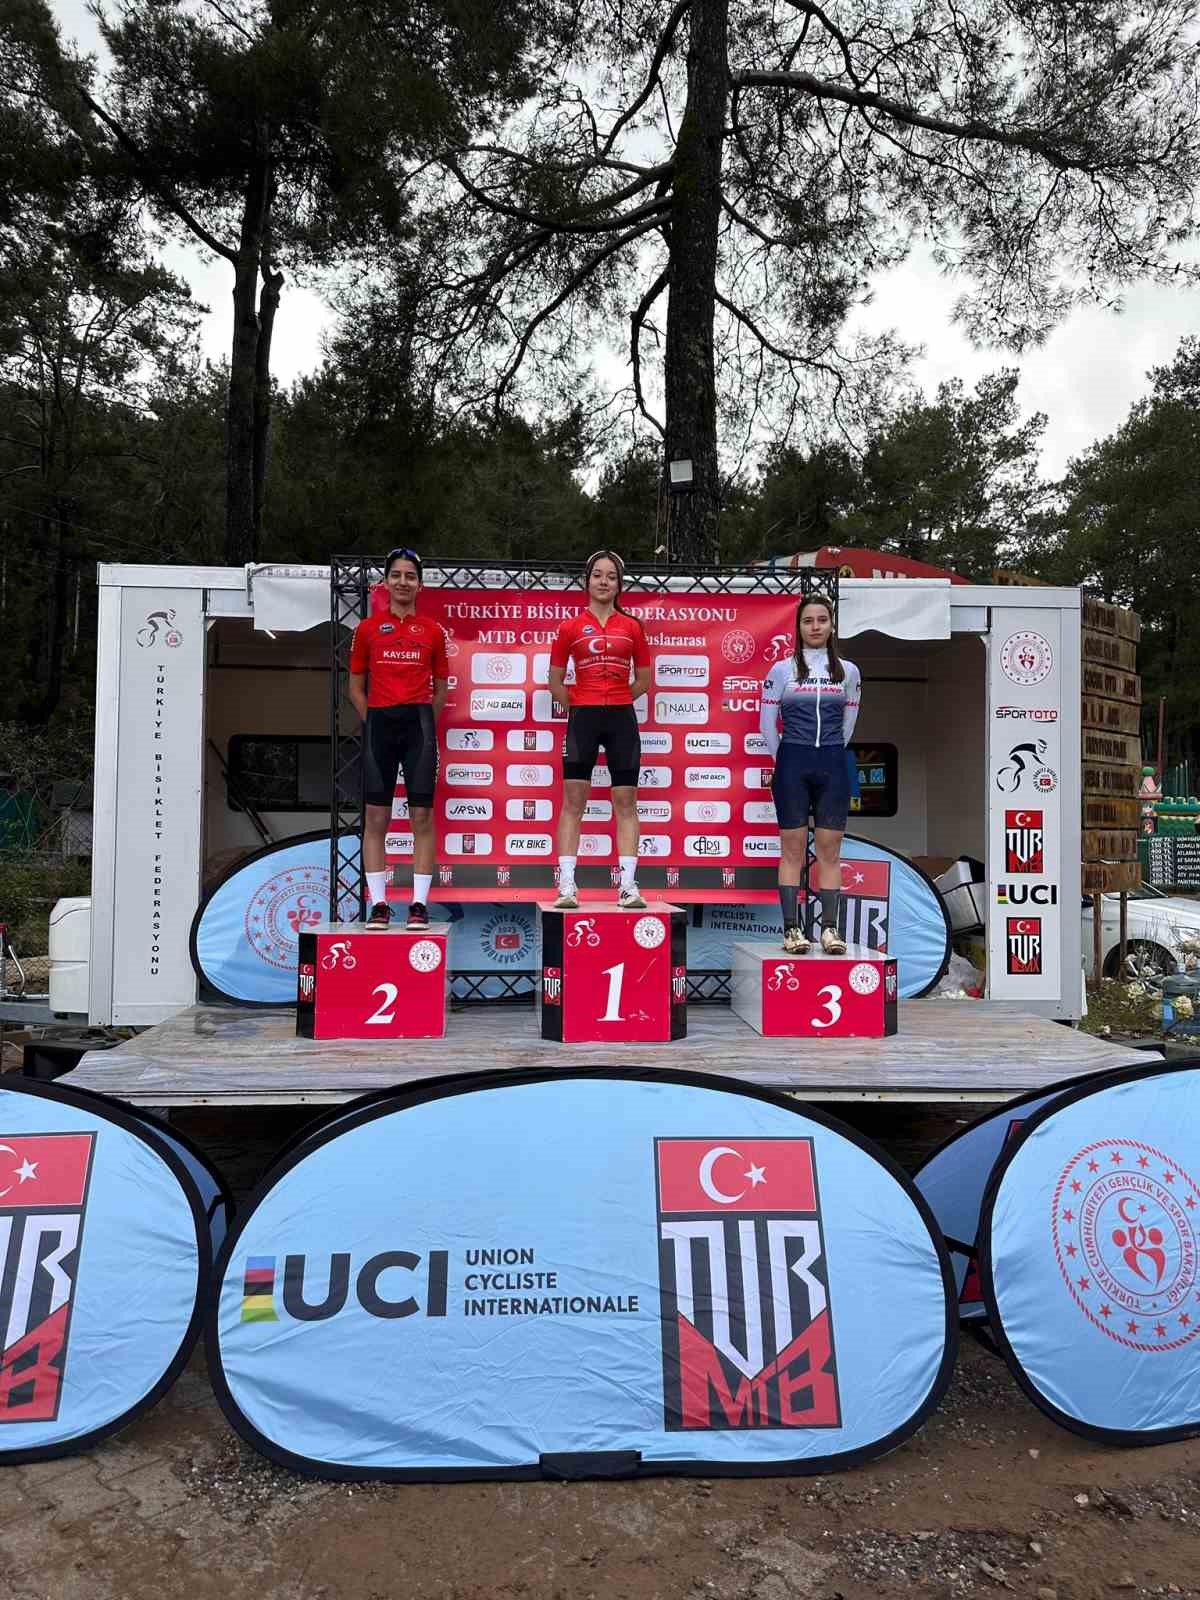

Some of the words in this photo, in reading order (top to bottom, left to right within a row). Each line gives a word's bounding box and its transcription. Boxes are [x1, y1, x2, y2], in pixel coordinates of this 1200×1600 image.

[444, 602, 522, 619] TÜRKİYE
[527, 603, 588, 619] BİSİKL
[477, 631, 515, 644] MTB
[520, 631, 557, 644] CUP
[646, 632, 705, 647] uslararası
[658, 667, 706, 675] SPORTOTO
[722, 680, 764, 690] SPORT
[154, 665, 165, 739] TÜRKİYE
[669, 703, 706, 712] NAULA
[729, 699, 759, 711] UCI
[995, 709, 1058, 719] SPORTOTO
[691, 739, 709, 747] UCI
[154, 753, 163, 839] BİSİKLET
[511, 839, 524, 848] FIX
[527, 839, 547, 848] BIKE
[1008, 884, 1057, 905] UCI
[150, 855, 162, 975] FEDERASYONU
[711, 911, 756, 920] CYCLISTE
[711, 921, 783, 934] INTERNATIONA
[596, 962, 626, 1021] 1
[365, 982, 399, 1024] 2
[811, 985, 843, 1028] 3
[1108, 1175, 1153, 1192] GENÇLİK
[1155, 1188, 1169, 1203] VE
[1083, 1182, 1110, 1267] CUMHURİYETİ
[1168, 1202, 1189, 1237] SPOR
[465, 1248, 534, 1266] UNION
[464, 1272, 557, 1290] CYCLISTE
[1168, 1242, 1194, 1303] BAKANLIĞI
[282, 1250, 449, 1322] UCI
[1095, 1269, 1141, 1309] TÜRKİYE
[464, 1295, 639, 1317] INTERNATIONALE
[660, 1220, 828, 1381] TUR
[678, 1309, 838, 1428] MTB
